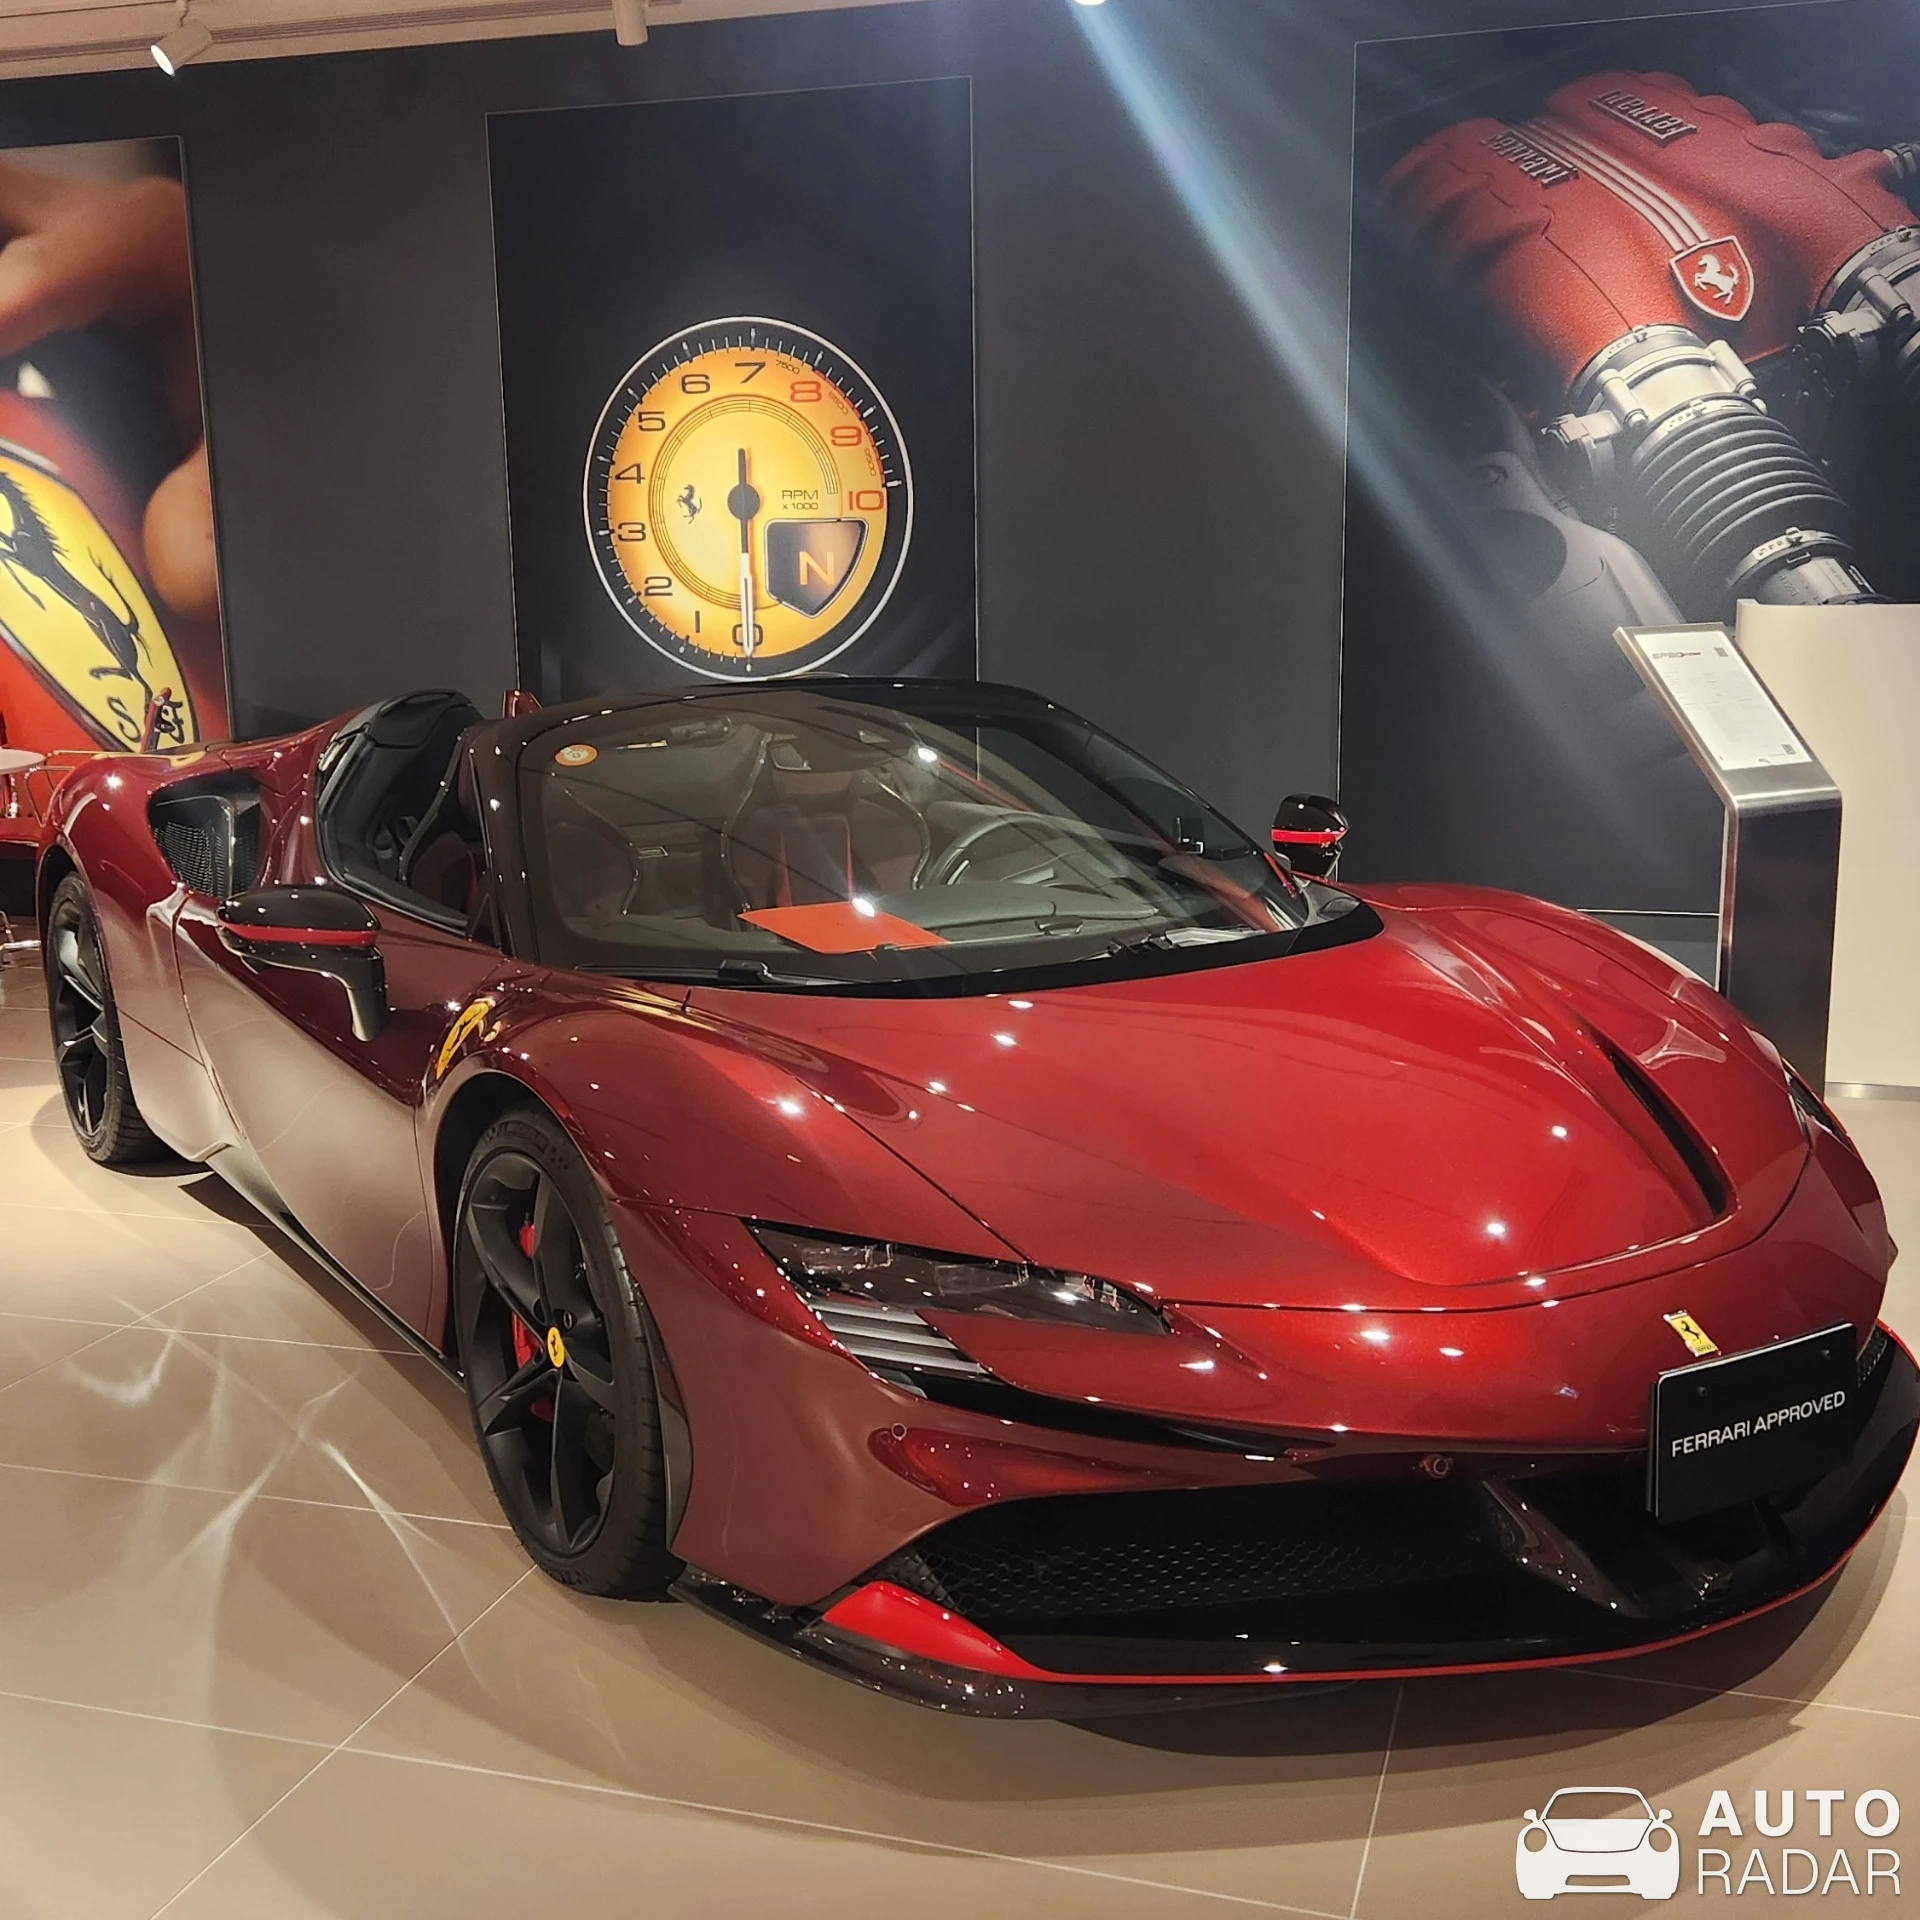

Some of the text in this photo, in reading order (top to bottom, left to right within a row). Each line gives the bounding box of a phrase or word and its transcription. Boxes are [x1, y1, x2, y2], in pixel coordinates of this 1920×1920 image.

[734, 361, 766, 384] 7
[776, 359, 800, 374] 7500
[681, 373, 711, 394] 6
[790, 381, 822, 402] 8
[638, 411, 666, 432] 5
[831, 426, 862, 447] 9
[615, 463, 645, 484] 4
[782, 489, 819, 500] RPM
[848, 490, 884, 511] 10
[792, 502, 819, 510] 1000
[617, 522, 646, 542] 3
[799, 551, 835, 586] N
[644, 576, 673, 597] 2
[1672, 1390, 1845, 1457] FERRARI APPROVED
